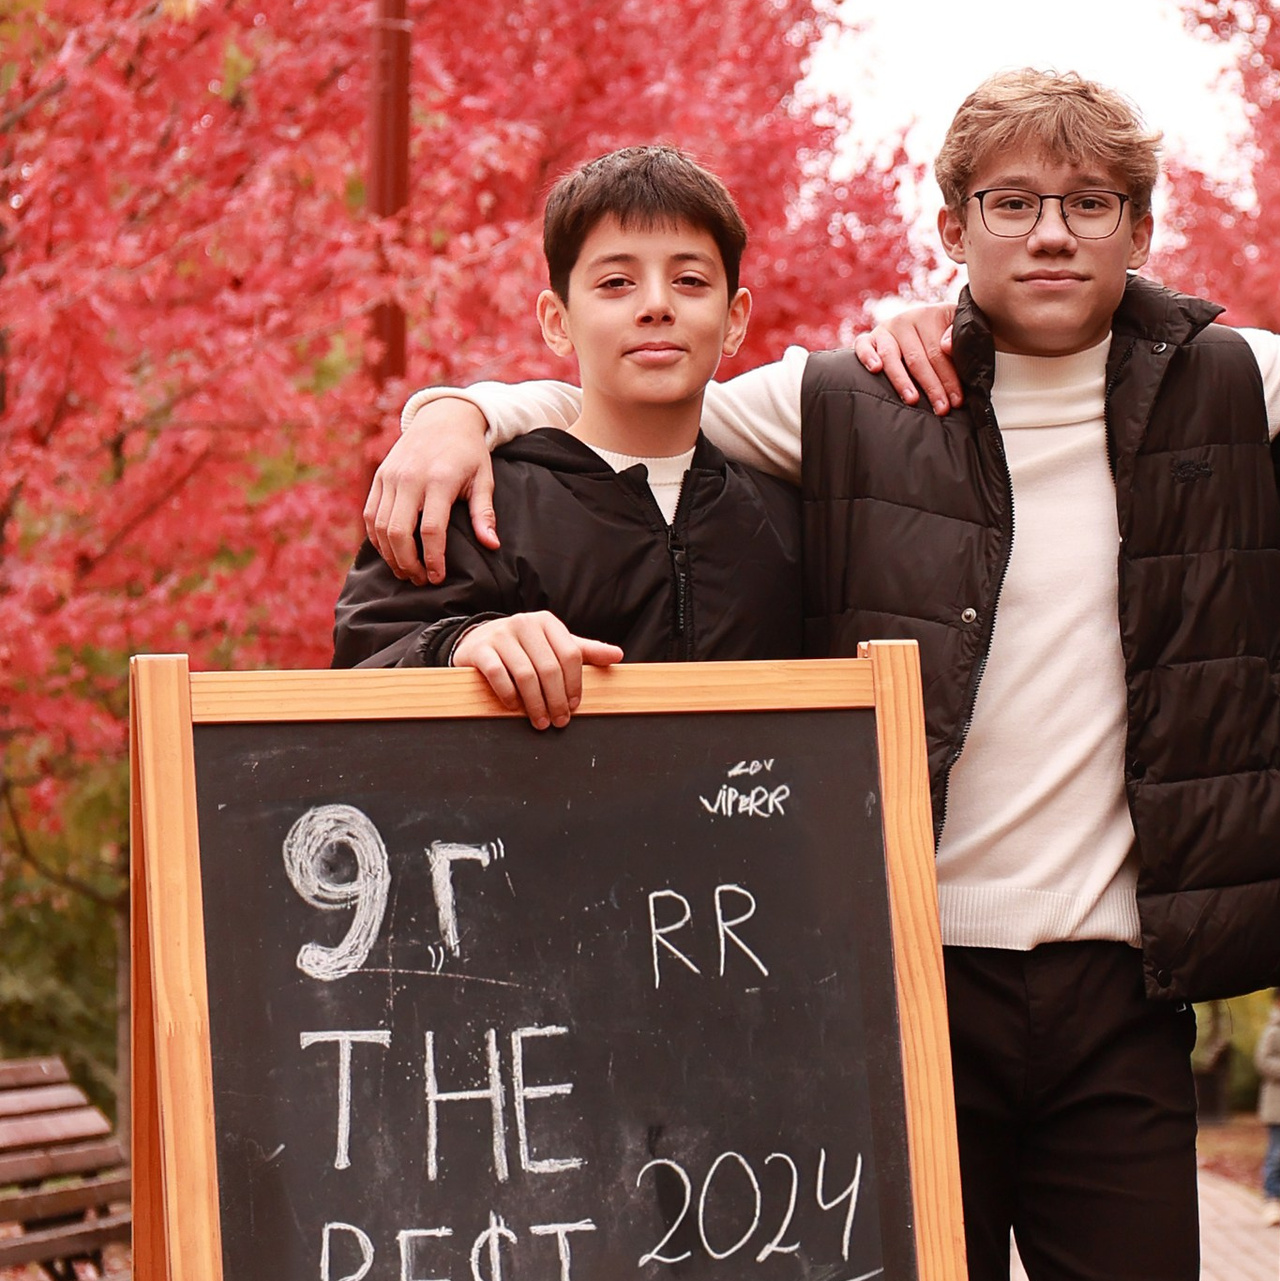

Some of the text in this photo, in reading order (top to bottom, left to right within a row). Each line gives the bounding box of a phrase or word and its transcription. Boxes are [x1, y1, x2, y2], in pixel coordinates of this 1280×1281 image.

[648, 883, 769, 989] RR
[299, 1024, 583, 1183] THE
[636, 1149, 862, 1267] 2024
